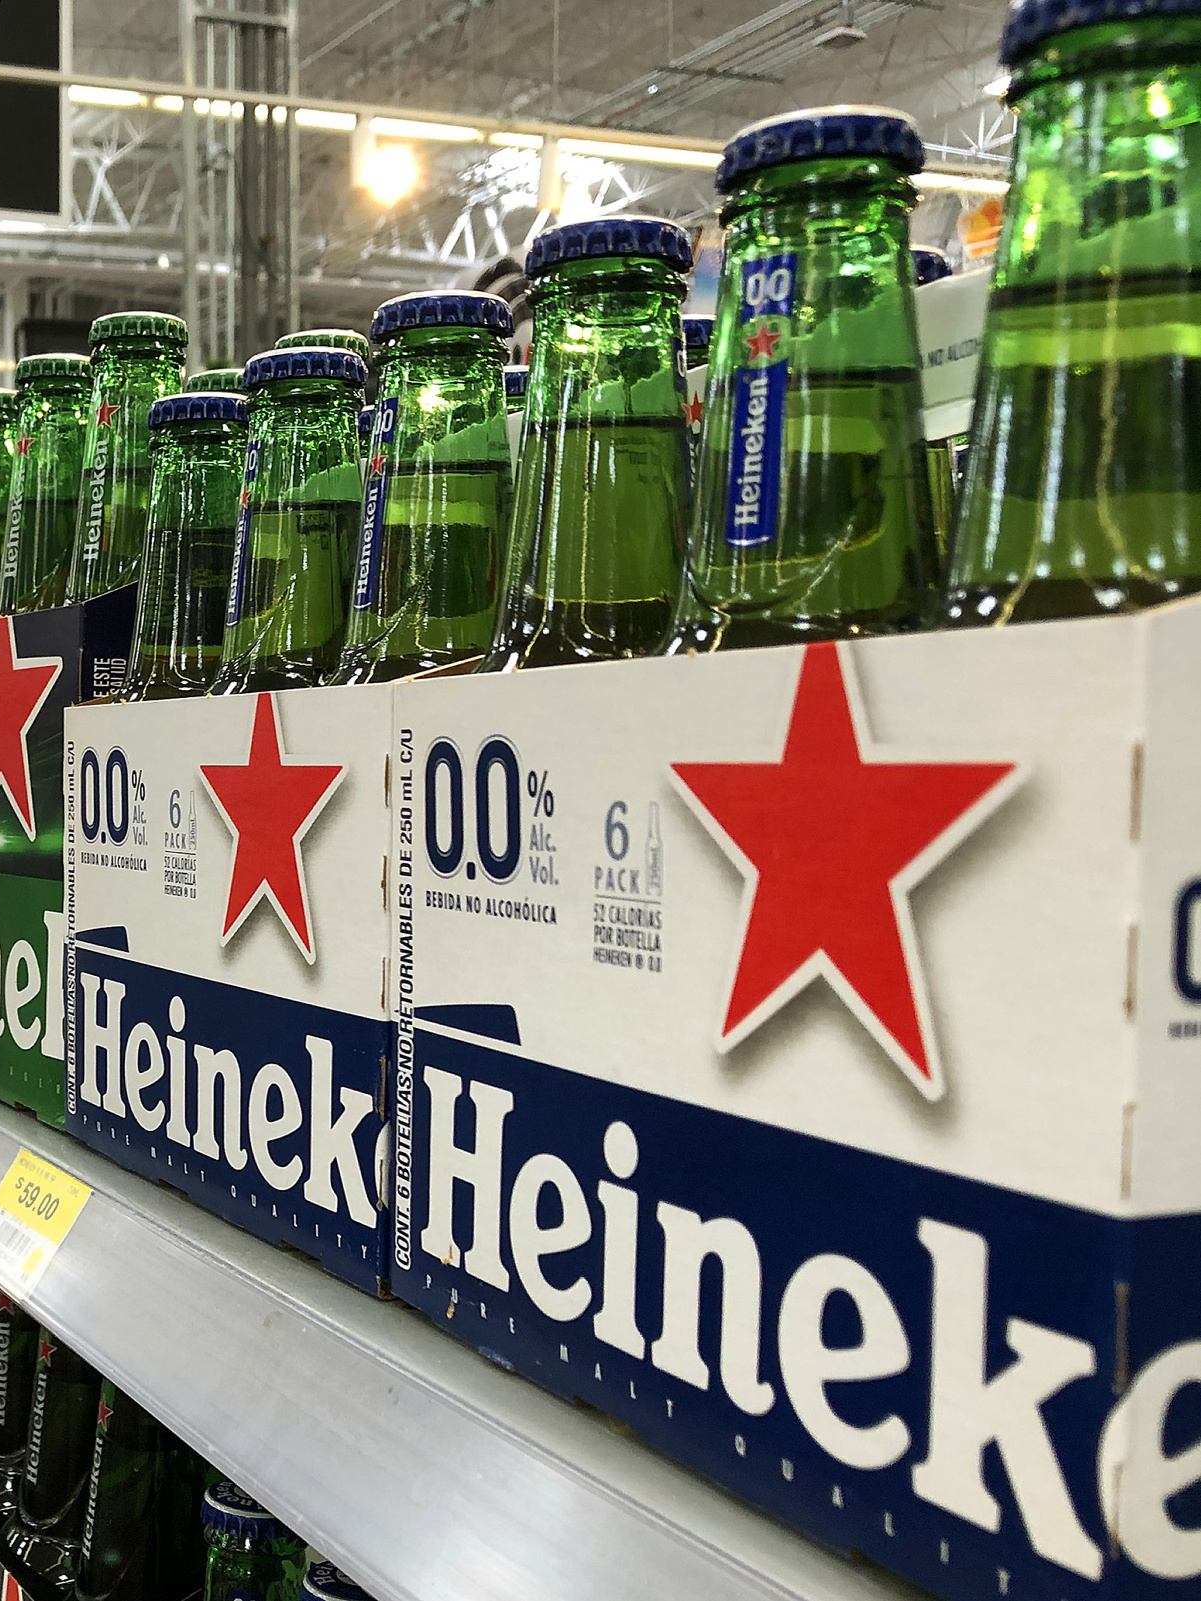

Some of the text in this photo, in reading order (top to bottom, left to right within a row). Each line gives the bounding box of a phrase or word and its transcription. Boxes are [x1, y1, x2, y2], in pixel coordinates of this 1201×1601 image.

[734, 376, 769, 528] Heineken
[83, 438, 108, 562] Heineken
[355, 486, 379, 595] Heineken
[94, 658, 110, 687] ESTE
[110, 658, 127, 696] SALUD
[68, 740, 76, 765] C/U
[68, 769, 76, 792] mL
[68, 795, 76, 821] 250
[132, 808, 147, 825] Alc.
[169, 789, 181, 829] 6
[68, 823, 76, 844] DE
[132, 827, 148, 847] Vol.
[164, 832, 187, 850] PACK
[529, 823, 557, 852] Alc.
[604, 800, 630, 861] 6
[81, 851, 147, 871] BEBIDA NO ALCOHÓLICA
[529, 856, 559, 885] Vol.
[594, 866, 640, 895] PACK
[425, 889, 558, 925] BEBIDA NO ALCOHÓLICA
[593, 902, 605, 922] 52
[593, 924, 613, 944] POR
[396, 728, 414, 1270] CONT. 6 BOTELLAS NO RETORNABLES DE 250 mL C/U
[67, 1070, 76, 1115] CONT.
[80, 972, 388, 1228] Heinek
[15, 1177, 60, 1221] $59.00
[82, 1114, 367, 1260] PURE MALT QUALITY
[26, 1372, 48, 1485] Heineken
[426, 1274, 1010, 1596] PURE MALT QUALIT
[82, 1436, 104, 1559] Heineken
